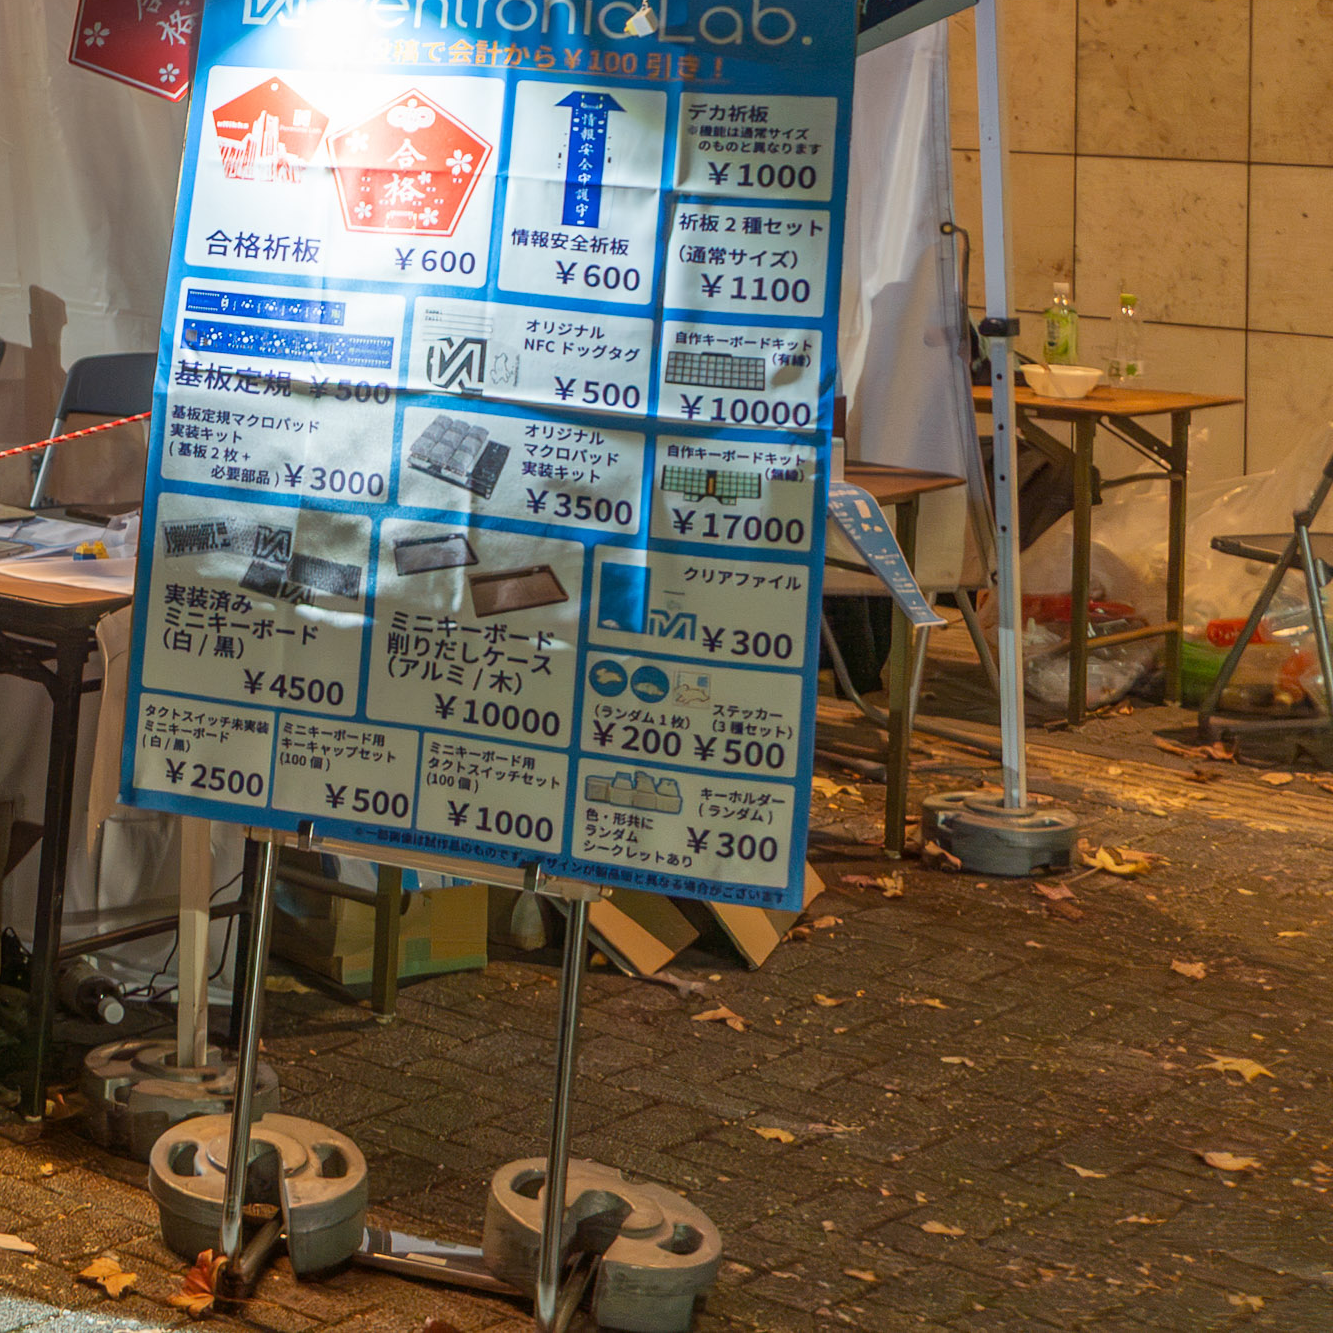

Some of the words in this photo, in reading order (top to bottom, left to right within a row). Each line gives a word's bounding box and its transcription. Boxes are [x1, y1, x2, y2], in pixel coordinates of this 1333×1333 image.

[687, 103, 769, 124] デカ祈板
[383, 138, 427, 206] 合格
[707, 161, 817, 190] ¥1000
[205, 228, 322, 264] 合格祈板
[511, 227, 630, 257] 情報安全祈板
[394, 246, 476, 275] ¥600
[555, 260, 641, 292] ¥600
[700, 272, 811, 304] ¥1100
[523, 337, 556, 354] NFC
[526, 318, 606, 340] オリジナル
[675, 330, 813, 352] 自作キーボードキット
[174, 358, 293, 398] 基板定規
[308, 375, 391, 405] ¥500
[554, 375, 641, 409] ¥500
[679, 393, 812, 427] ¥10000
[169, 422, 244, 445] 実装キット
[524, 423, 605, 446] オリジナル
[521, 460, 602, 484] 実装キット
[667, 444, 806, 467] 自作キーボードキット
[283, 462, 384, 497] ¥3000
[525, 487, 633, 526] ¥3500
[671, 507, 805, 545] ¥17000
[683, 566, 802, 592] クリアファイル
[163, 582, 253, 615] 実装済み
[164, 606, 320, 647] ミニキーボード
[391, 610, 555, 652] ミニキーボード
[701, 625, 794, 661] ¥300
[387, 631, 552, 677] 削りだしケース
[243, 668, 345, 707] ¥4500
[434, 692, 561, 738] ¥10000
[712, 703, 784, 722] ステッカー
[144, 719, 230, 744] ミニキーボード
[592, 719, 683, 758] ¥200
[693, 733, 785, 770] ¥500
[165, 757, 265, 798] ¥2500
[324, 782, 410, 819] ¥500
[446, 799, 554, 844] ¥1000
[584, 823, 639, 845] ランダム
[685, 826, 779, 864] ¥300
